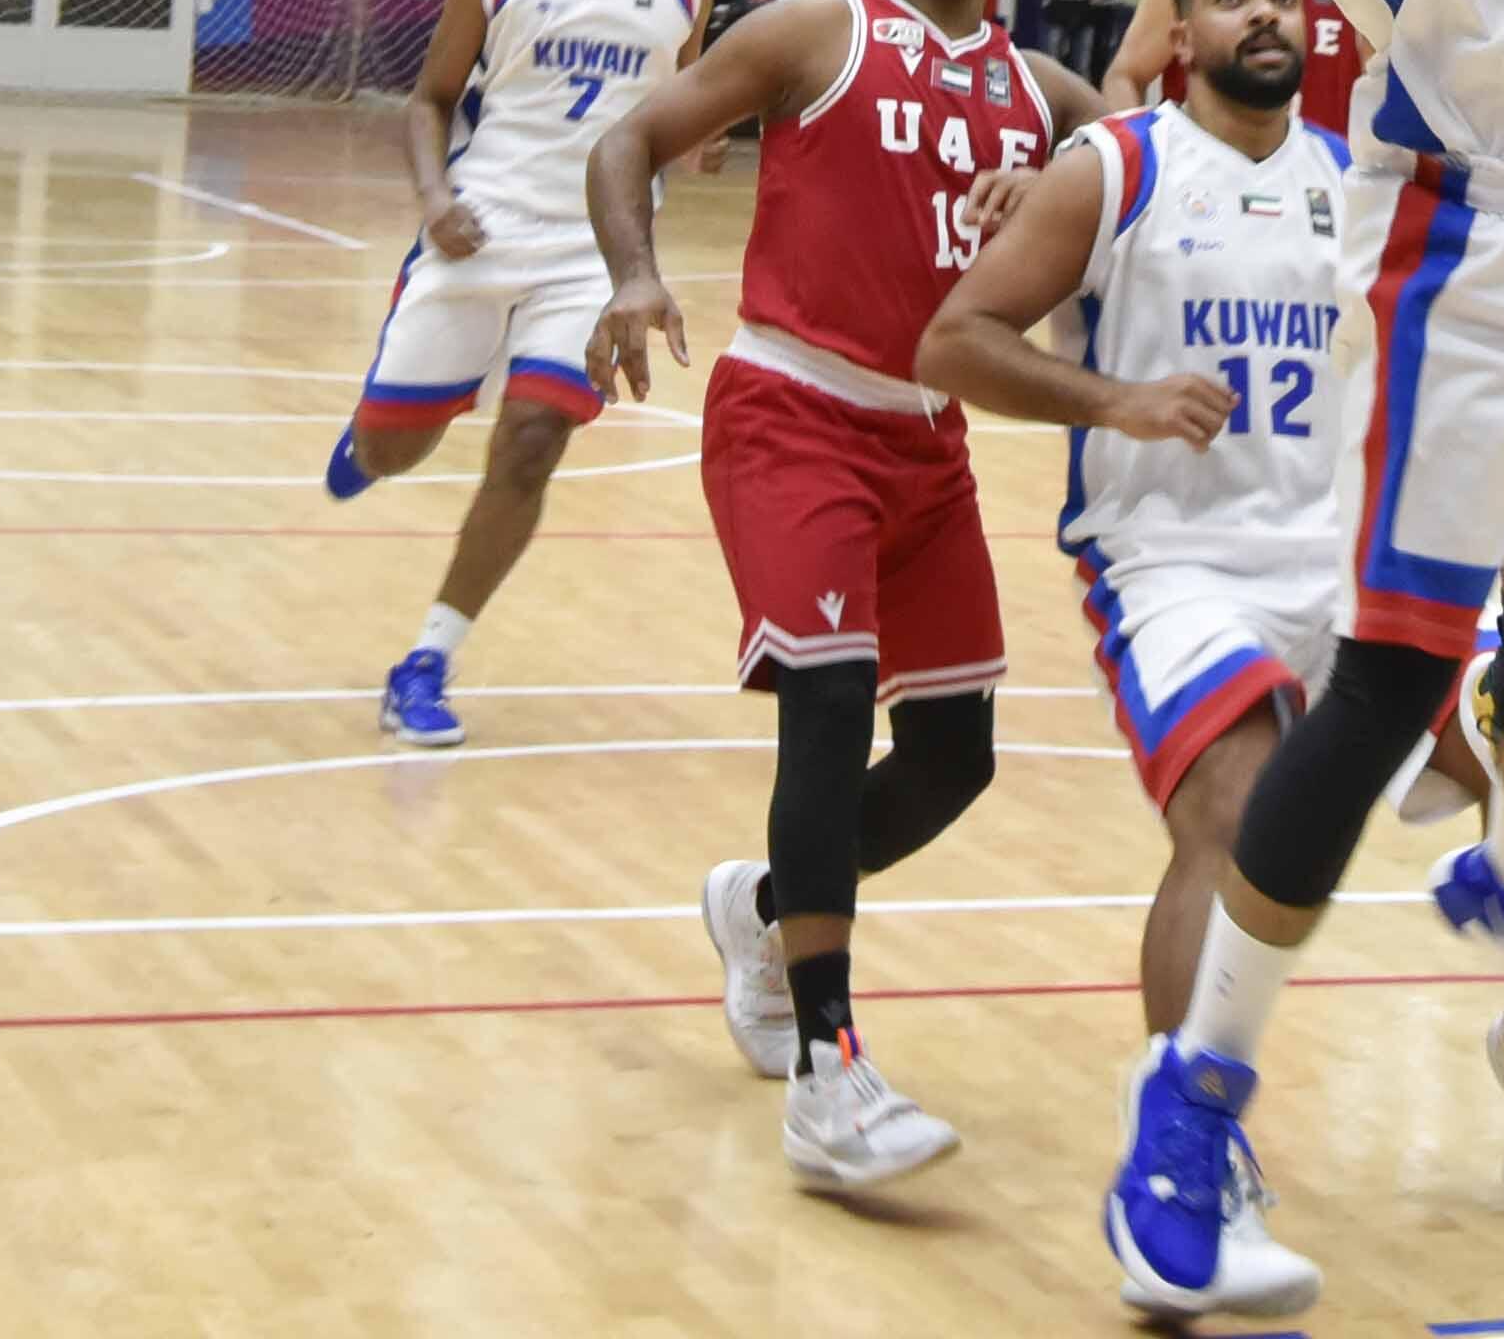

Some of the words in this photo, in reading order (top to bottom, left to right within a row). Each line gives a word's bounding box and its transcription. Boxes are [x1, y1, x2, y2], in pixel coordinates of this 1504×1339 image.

[532, 37, 651, 78] KUWAIT
[565, 74, 604, 121] 7
[876, 98, 1039, 173] UAE
[1217, 355, 1316, 438] 12
